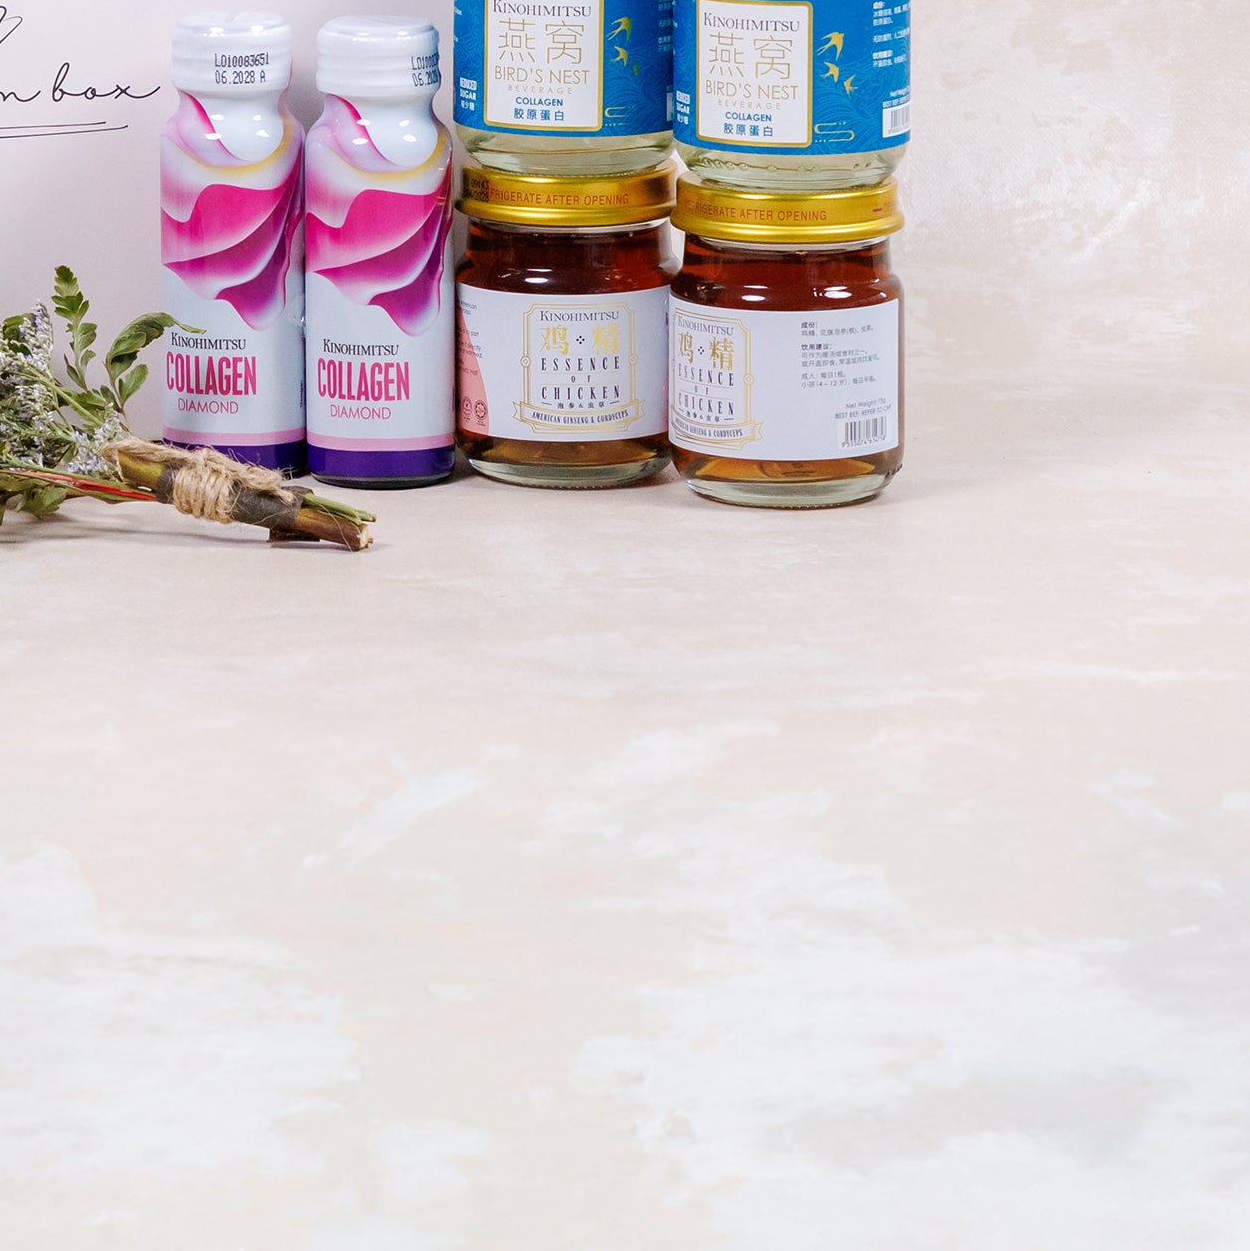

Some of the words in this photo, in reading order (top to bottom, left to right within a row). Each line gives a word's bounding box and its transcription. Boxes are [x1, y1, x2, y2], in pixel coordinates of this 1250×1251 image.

[703, 12, 800, 32] KINOHIMITSU
[497, 17, 585, 65] 燕窝
[708, 32, 793, 80] 燕窝
[51, 62, 162, 103] box
[214, 69, 256, 85] 06.2028
[259, 69, 266, 83] A
[494, 65, 543, 82] BIRD'S
[549, 69, 591, 85] NEST
[507, 84, 574, 95] BEVERAGE
[705, 80, 752, 99] BIRD'S
[758, 85, 799, 101] NEST
[515, 96, 564, 107] COLLAGEN
[717, 99, 782, 111] BEVERAGE
[513, 108, 565, 122] 胶原蛋白
[725, 111, 772, 123] COLLAGEN
[723, 123, 774, 137] 胶原蛋白
[545, 194, 580, 206] AFTER
[584, 193, 630, 207] OPENING
[739, 208, 774, 221] AFTER
[777, 209, 827, 221] OPENING
[540, 310, 620, 322] KINOHIMITSU
[678, 316, 734, 336] KINOHIMITSU
[170, 332, 247, 350] KINOHIMITSU
[323, 338, 400, 356] KINOHIMITSU
[541, 355, 620, 372] ESSENCE
[166, 351, 257, 396] COLLAGEN
[317, 357, 410, 402] COLLAGEN
[570, 375, 592, 384] OF
[678, 363, 734, 387] ESSENCE
[541, 385, 621, 400] CHICKEN
[694, 386, 709, 395] OF
[177, 398, 239, 414] DIAMOND
[330, 404, 392, 420] DIAMOND
[678, 392, 734, 416] CHICKEN
[532, 411, 561, 423] AMERICAN
[563, 416, 589, 424] GINSENG
[597, 409, 629, 423] CORDYCEPS
